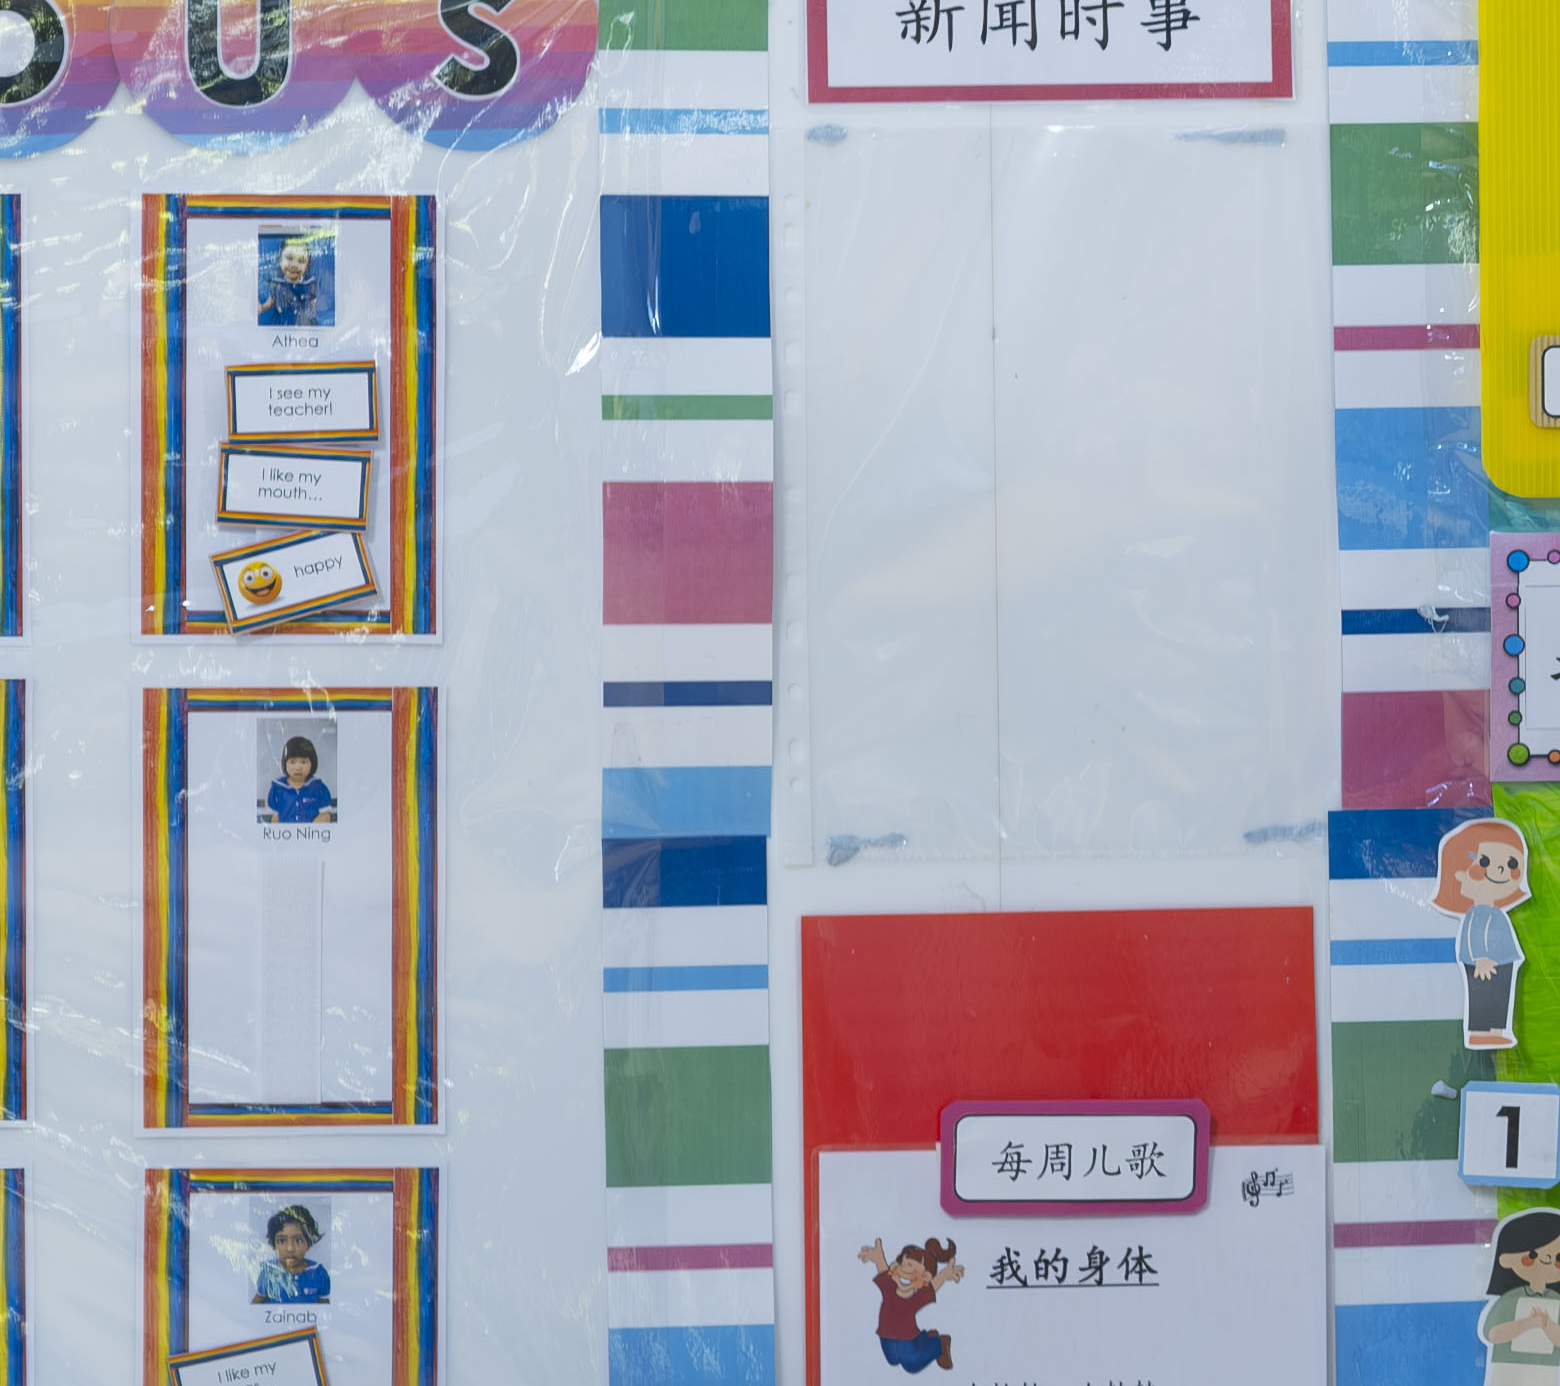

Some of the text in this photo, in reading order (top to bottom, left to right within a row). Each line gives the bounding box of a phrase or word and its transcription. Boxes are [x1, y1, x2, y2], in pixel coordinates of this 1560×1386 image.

[276, 387, 304, 400] see
[308, 387, 331, 405] my
[268, 403, 333, 417] teacher!
[269, 468, 294, 483] like
[298, 472, 322, 485] my
[258, 486, 323, 502] mouth...
[294, 557, 343, 578] happy
[263, 827, 331, 843] Ruo Ning
[1496, 1105, 1521, 1169] 1
[991, 1140, 1166, 1182] 每周儿歌
[988, 1245, 1162, 1289] 我的身体
[264, 1310, 317, 1324] Zainab
[225, 1368, 250, 1382] like
[254, 1362, 277, 1376] my
